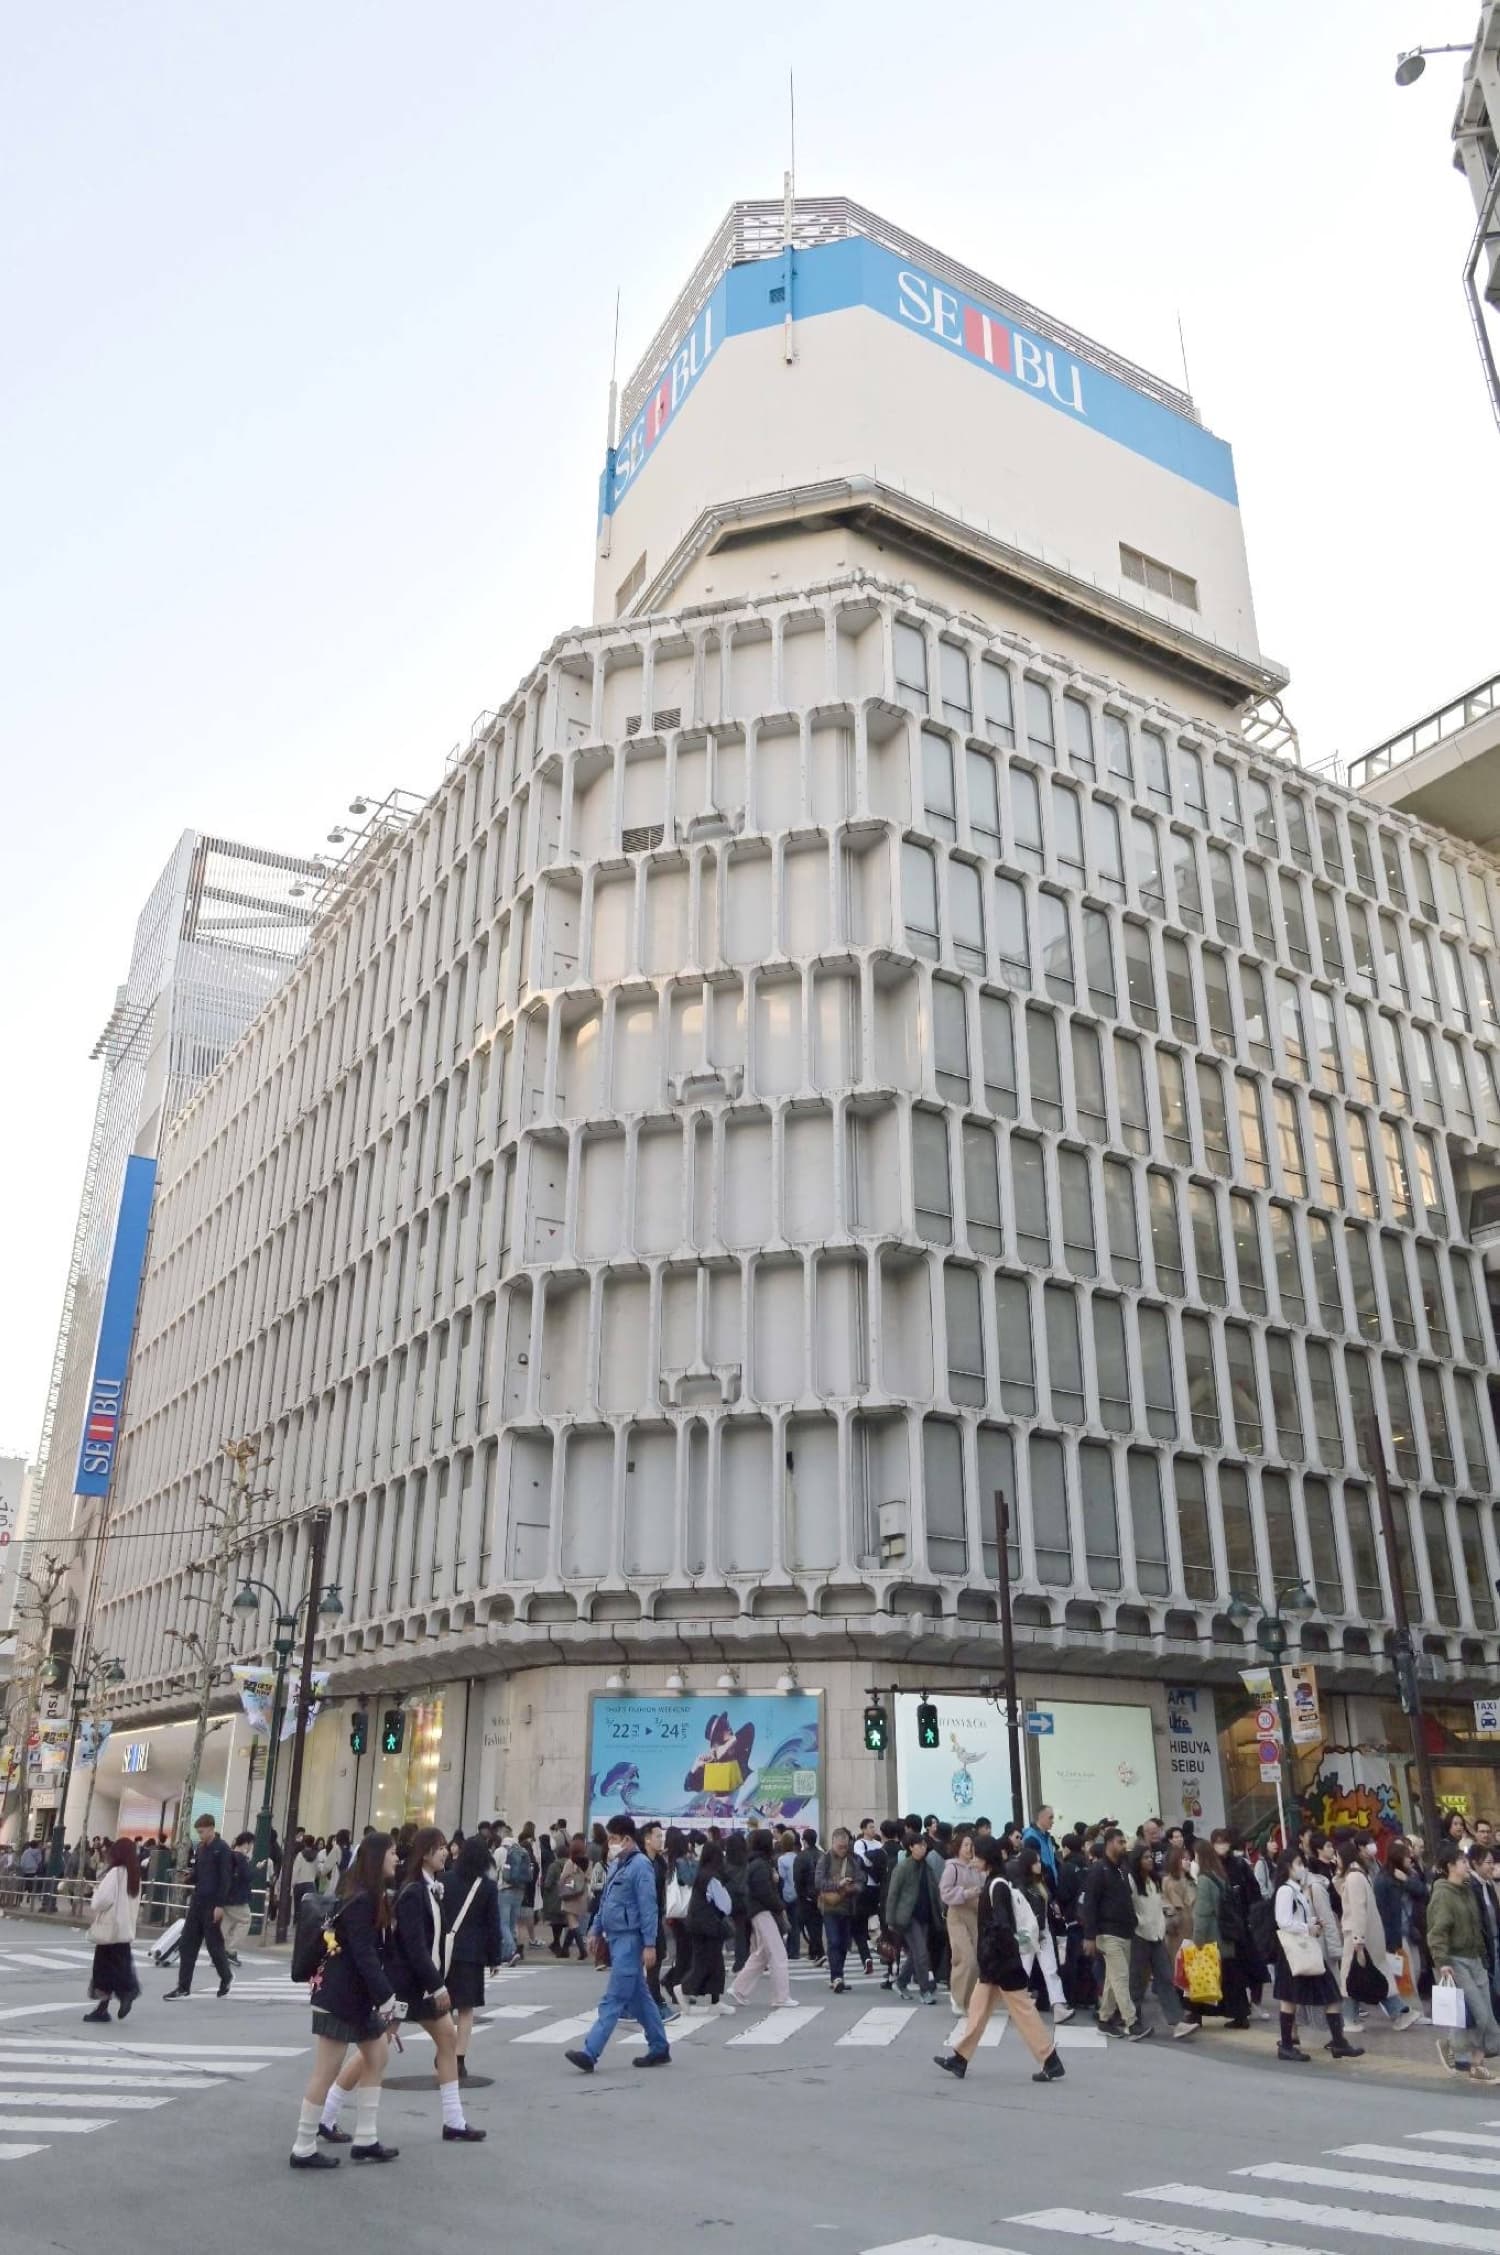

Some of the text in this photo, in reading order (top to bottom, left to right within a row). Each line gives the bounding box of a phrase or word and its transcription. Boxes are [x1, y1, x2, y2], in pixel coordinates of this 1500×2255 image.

[898, 271, 1087, 415] SEIBU
[615, 306, 712, 500] SEIBU
[83, 1379, 121, 1474] SEIBU
[1476, 1702, 1497, 1710] TAXI
[1169, 1740, 1211, 1754] HIBUYA
[1171, 1760, 1205, 1773] SEIBU
